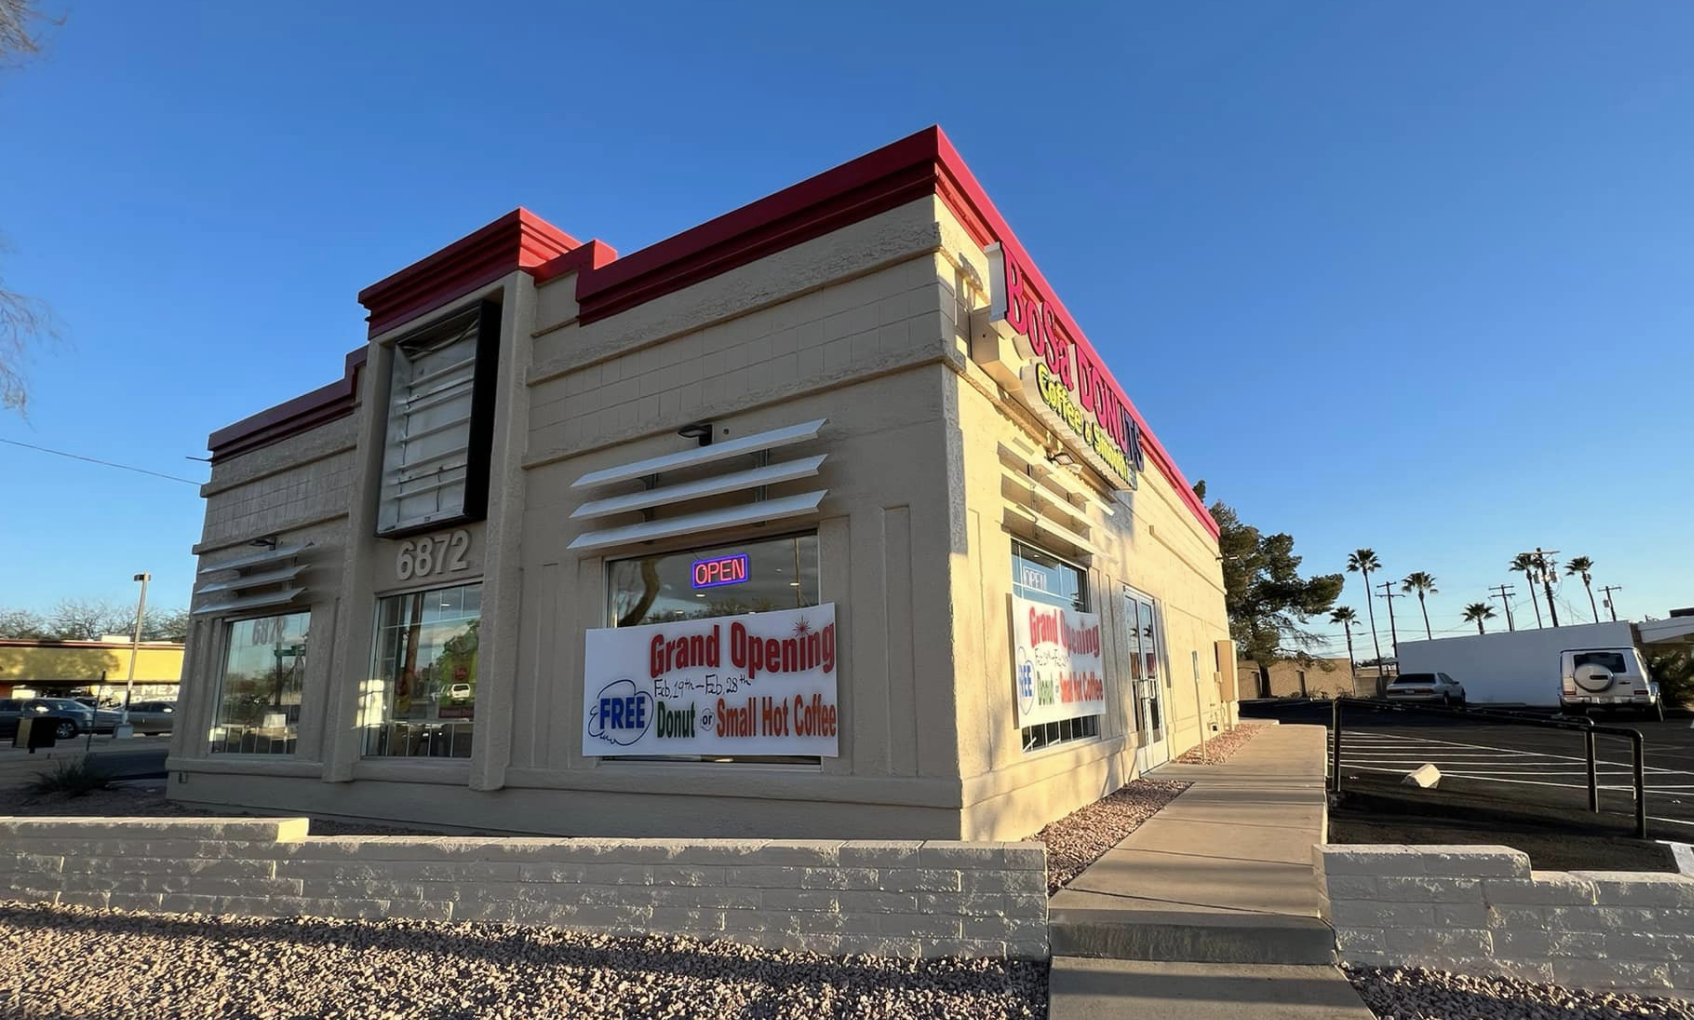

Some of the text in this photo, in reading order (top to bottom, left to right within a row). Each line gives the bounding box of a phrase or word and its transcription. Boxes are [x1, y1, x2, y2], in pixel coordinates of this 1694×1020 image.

[1035, 362, 1082, 438] Coffee
[1075, 342, 1145, 473] DONUTS
[396, 530, 470, 581] 6872
[694, 557, 746, 585] OPEN
[650, 621, 835, 679] Grand Opening
[1029, 605, 1058, 648] Grand
[600, 694, 837, 738] FREE Donut or Small Hot Coffee
